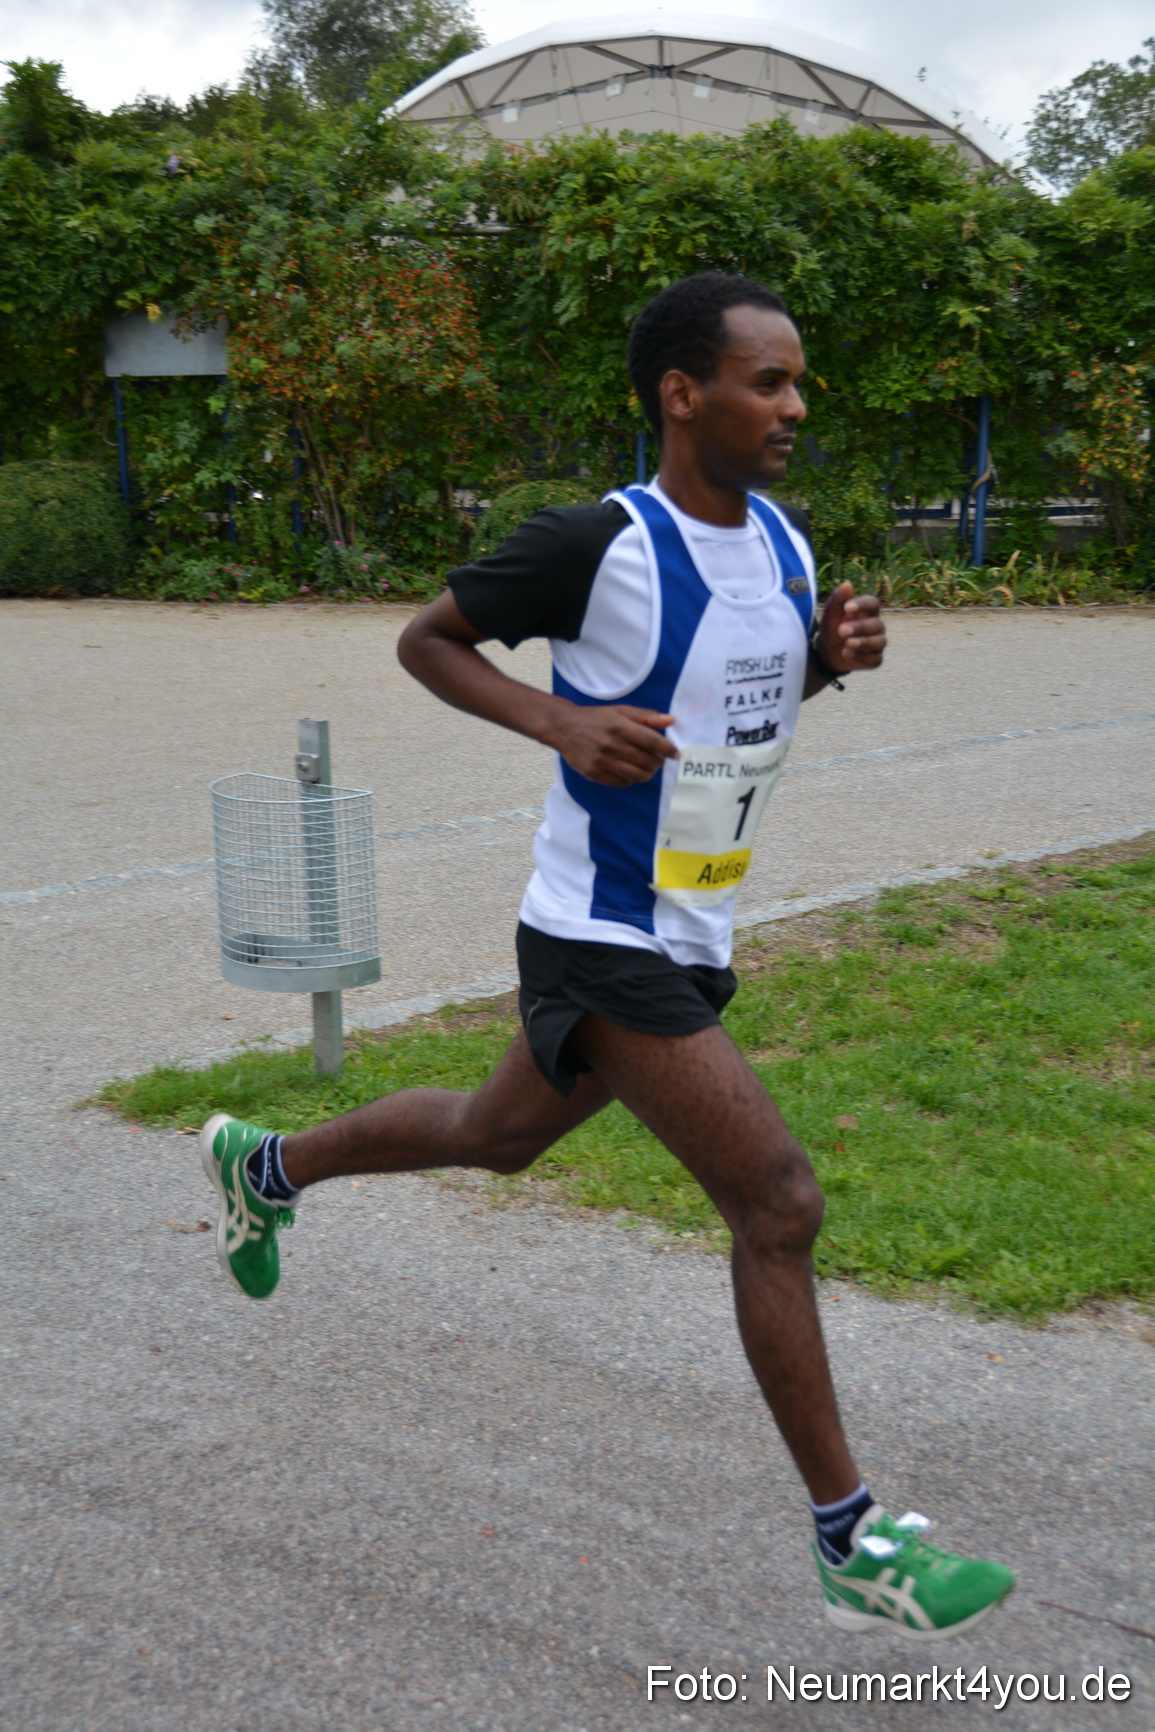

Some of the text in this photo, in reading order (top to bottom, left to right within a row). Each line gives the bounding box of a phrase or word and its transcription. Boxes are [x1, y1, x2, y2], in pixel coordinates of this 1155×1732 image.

[725, 686, 783, 709] FALKE
[683, 761, 735, 778] PARTL
[734, 786, 756, 841] 1
